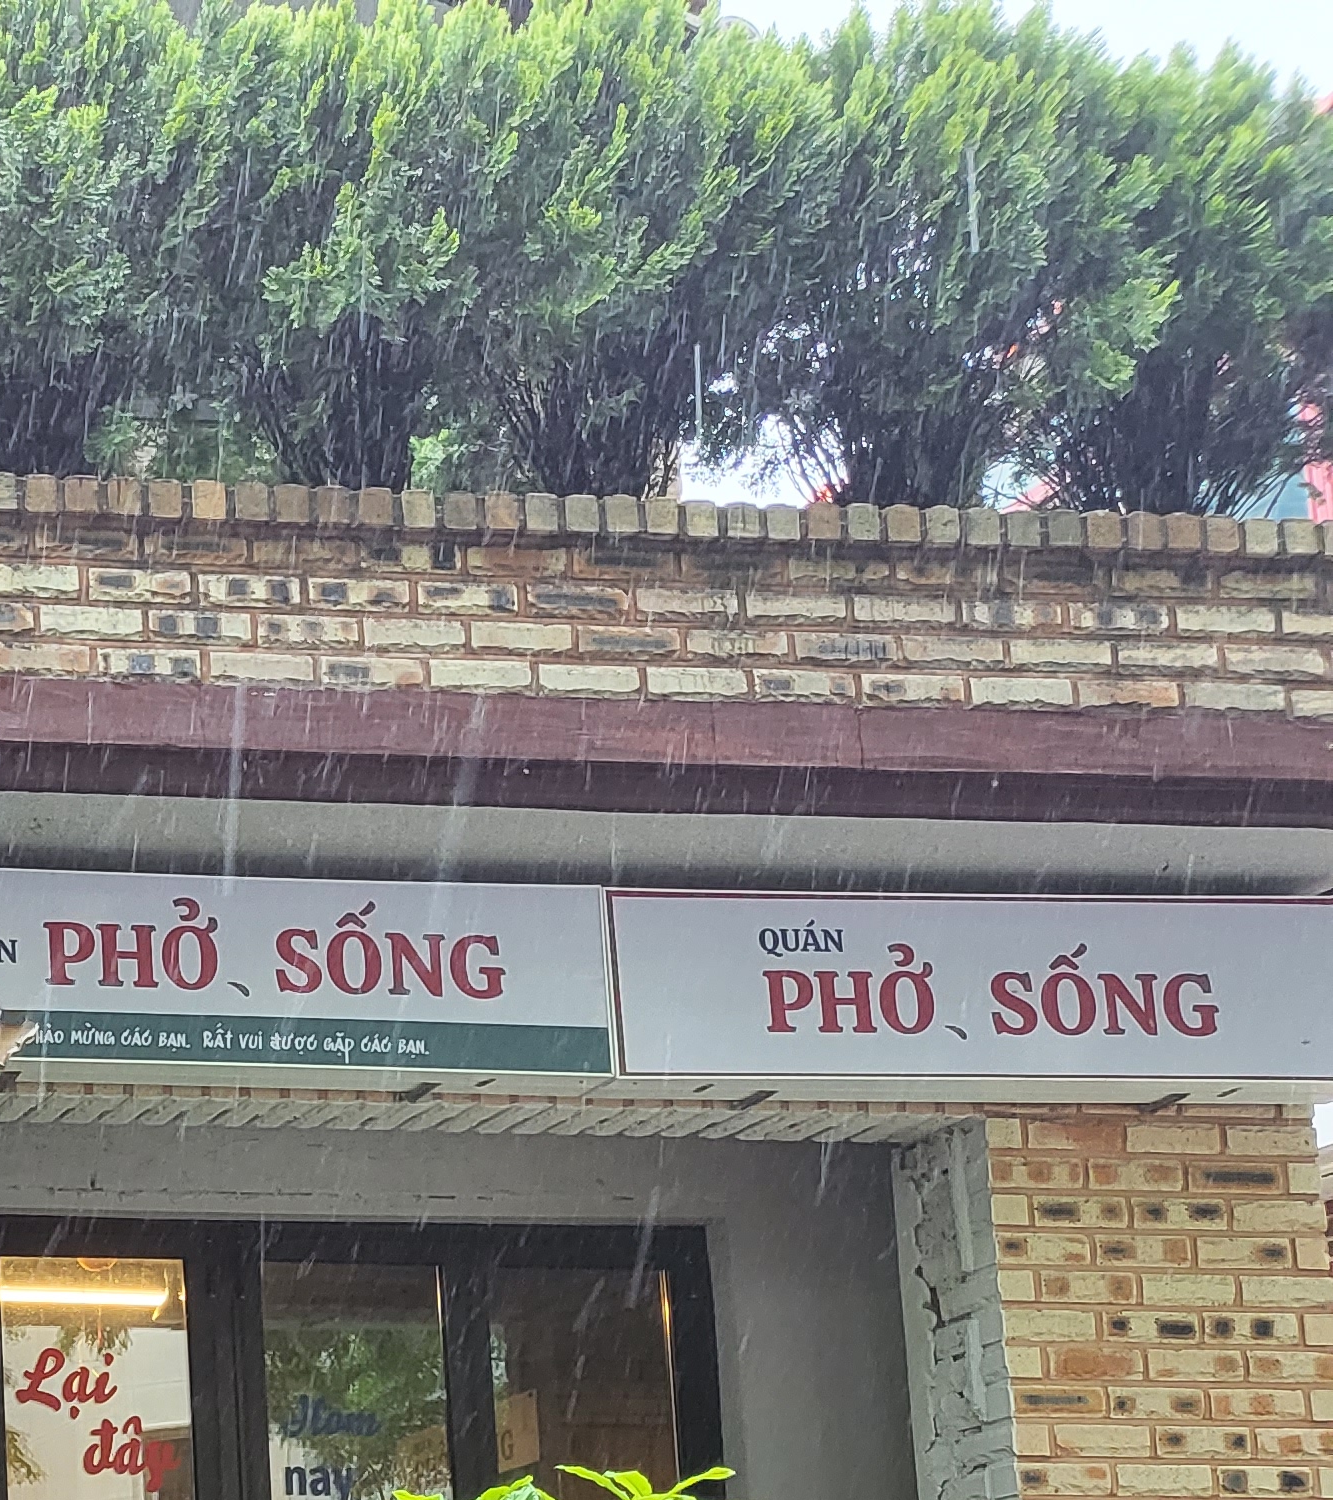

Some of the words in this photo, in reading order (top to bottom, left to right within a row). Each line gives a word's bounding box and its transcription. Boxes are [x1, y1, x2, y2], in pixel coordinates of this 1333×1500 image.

[42, 897, 219, 990] PHỞ
[275, 900, 507, 999] SỐNG
[758, 919, 845, 957] QUÁN
[761, 943, 935, 1036] PHỞ
[989, 943, 1220, 1037] SỐNG
[15, 1347, 119, 1420] Lại
[83, 1415, 182, 1493] đây
